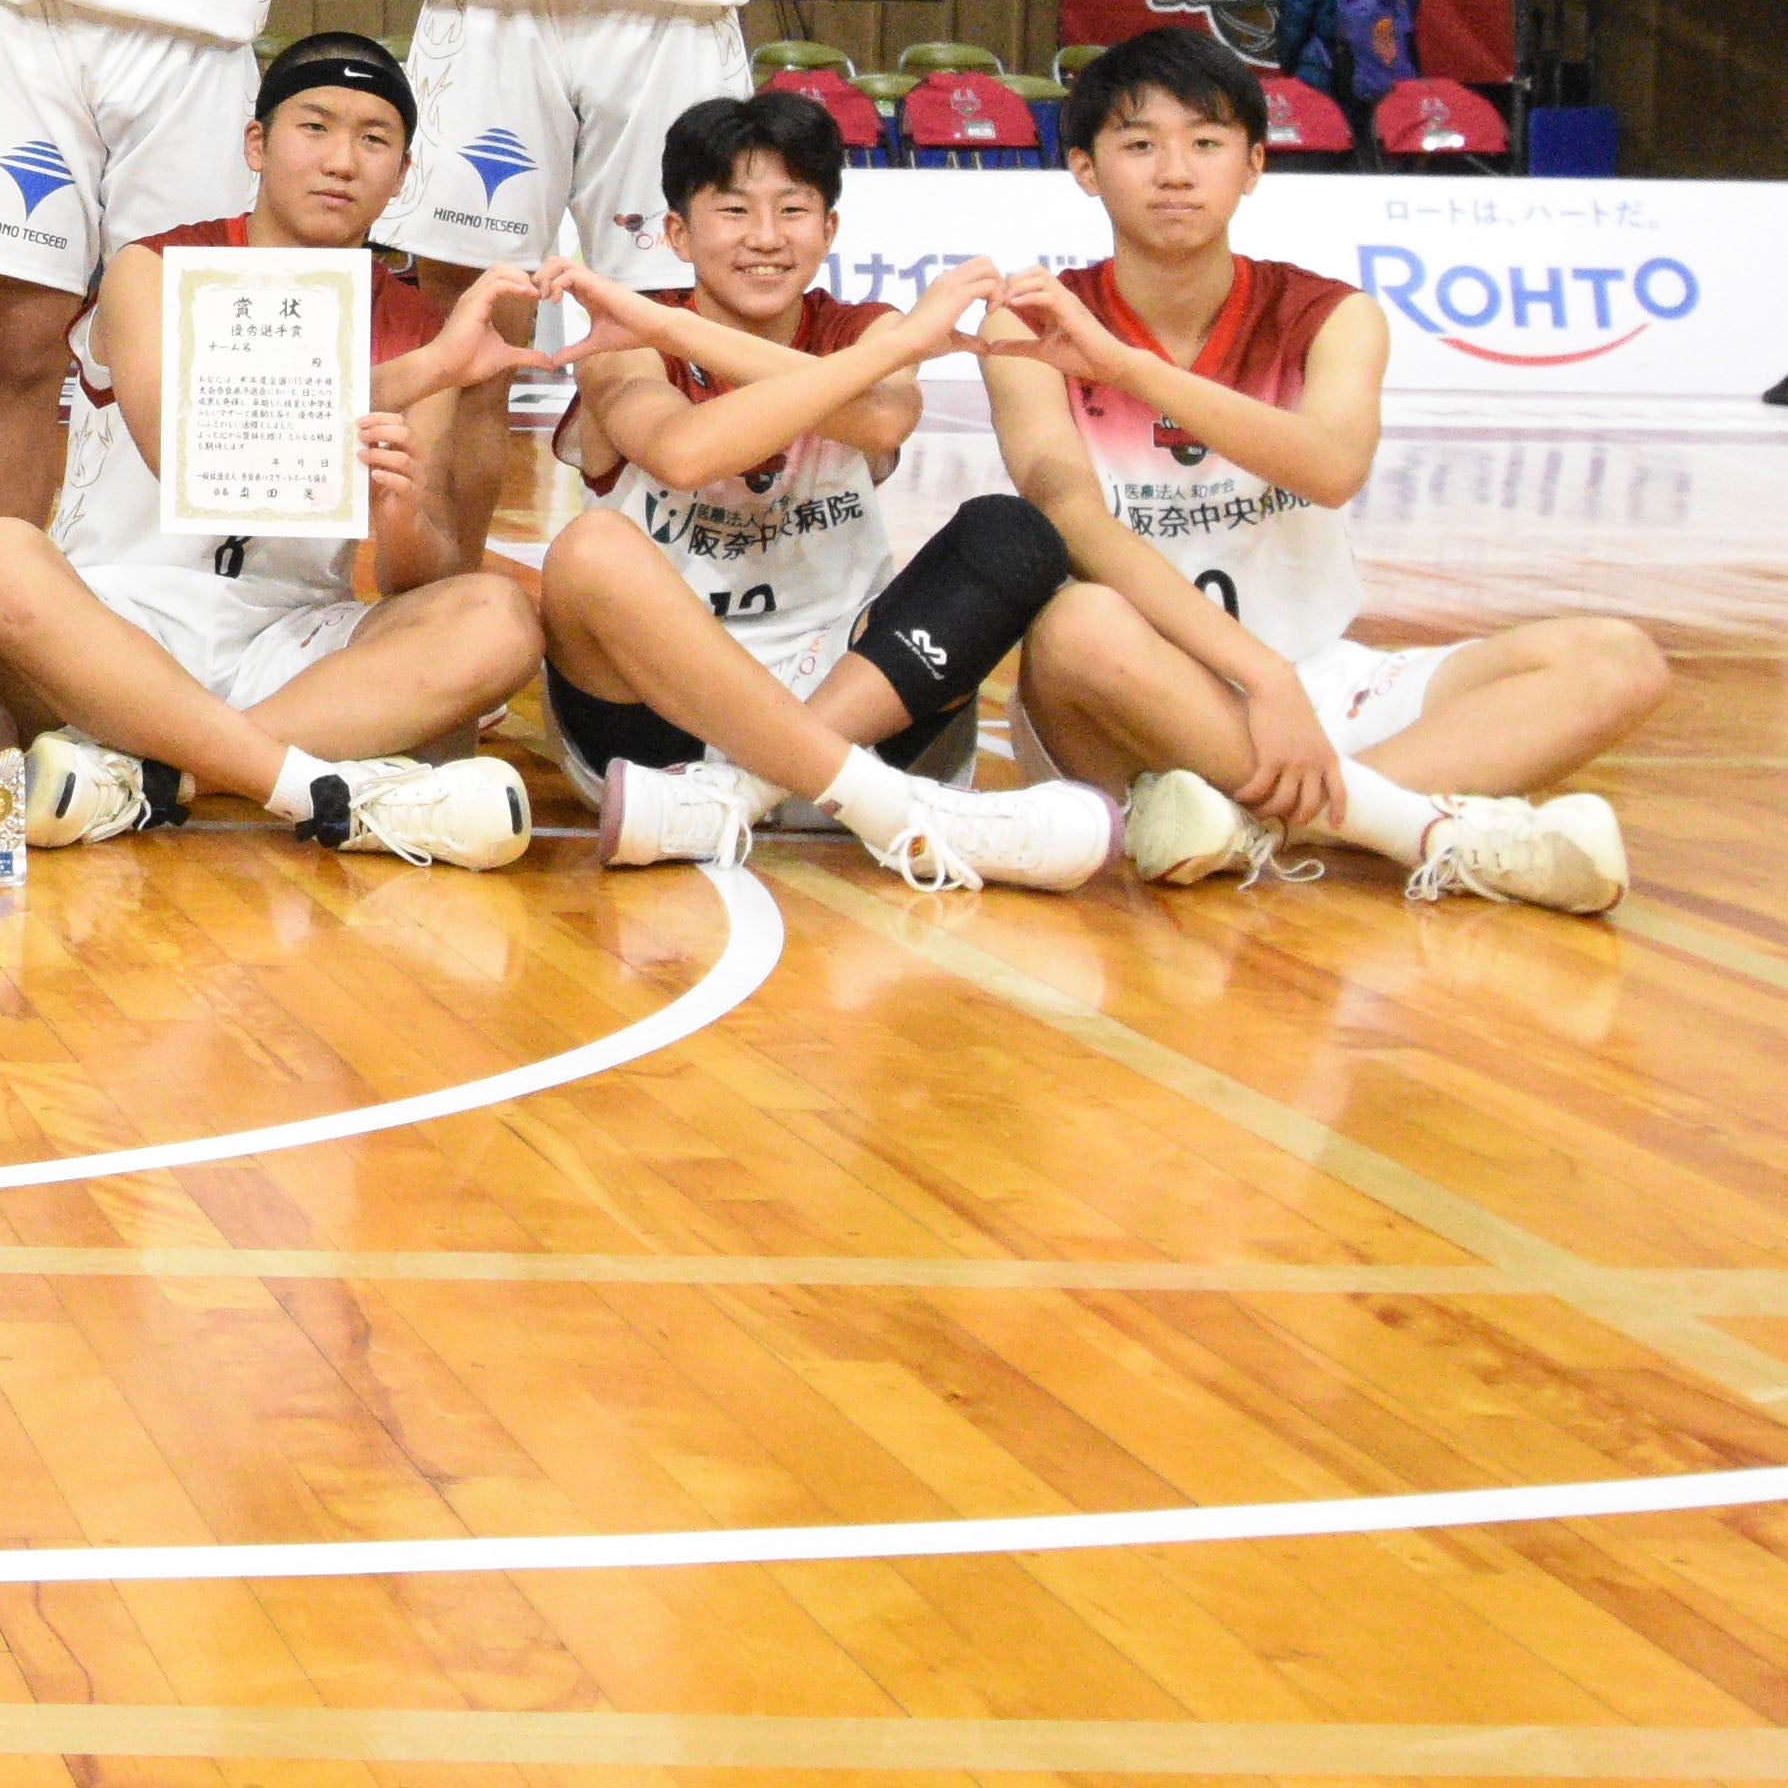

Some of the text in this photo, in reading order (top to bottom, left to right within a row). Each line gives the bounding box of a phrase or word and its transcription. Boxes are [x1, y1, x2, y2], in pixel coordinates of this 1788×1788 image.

[433, 206, 529, 236] HIRANO TECSEED
[22, 226, 68, 251] TECSEED
[1357, 245, 1701, 333] ROHTO
[231, 324, 302, 337] 優秀選手賞
